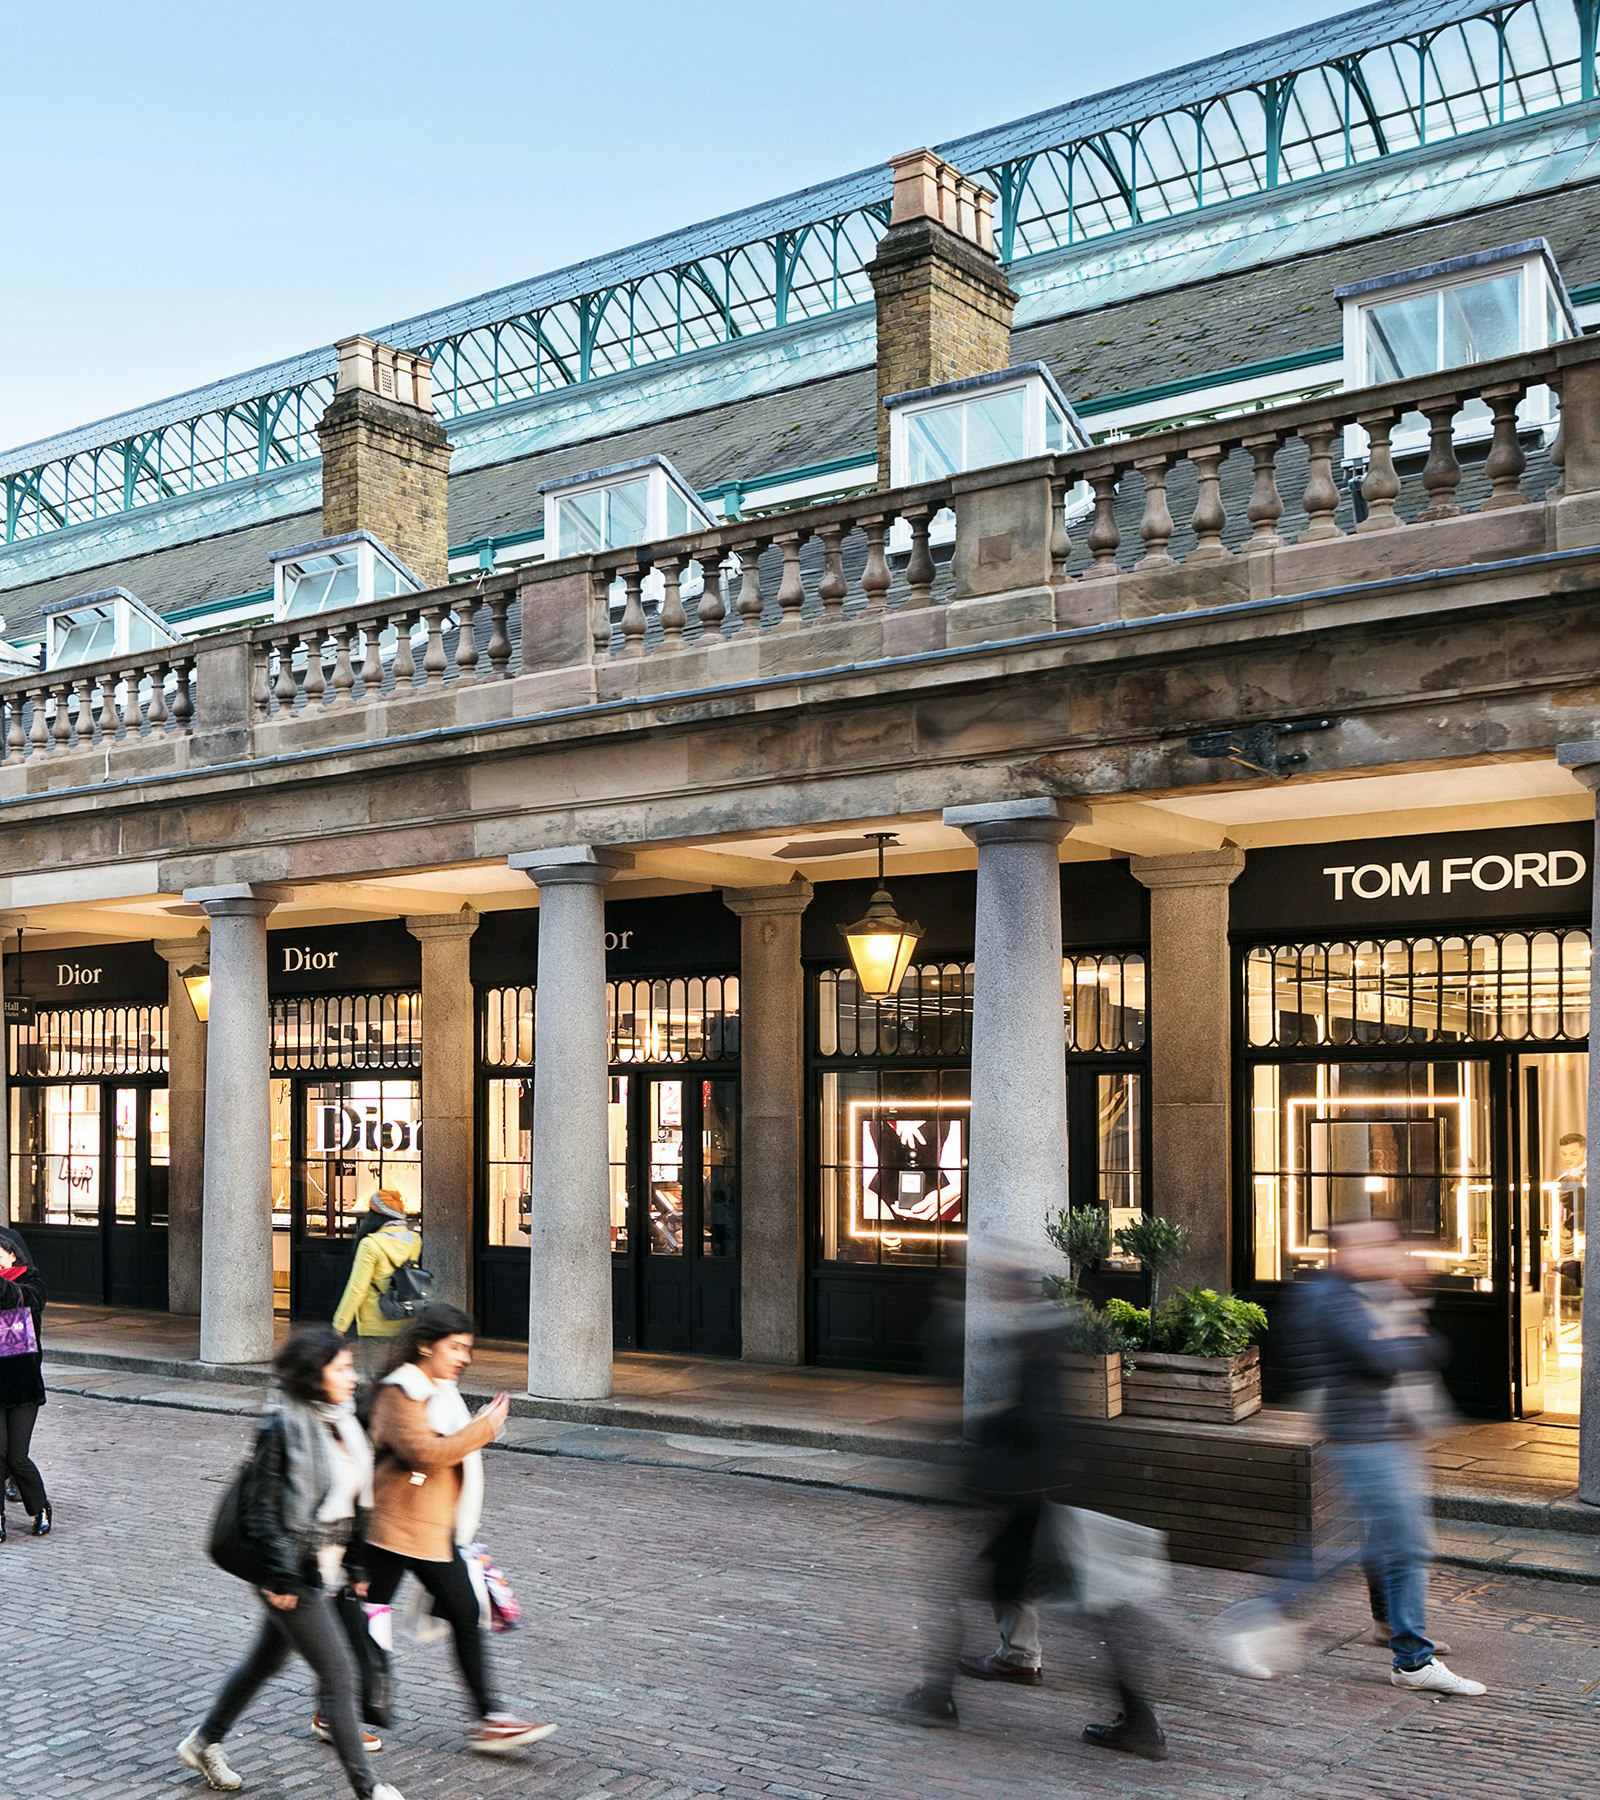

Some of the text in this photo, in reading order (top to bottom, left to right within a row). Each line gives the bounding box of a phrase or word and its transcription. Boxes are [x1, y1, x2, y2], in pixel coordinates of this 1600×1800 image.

[1323, 849, 1587, 901] TOM FORD
[604, 929, 634, 952] or
[282, 946, 339, 973] Dior
[56, 963, 102, 987] Dior
[4, 1001, 19, 1012] Hall
[311, 1105, 422, 1153] Dior
